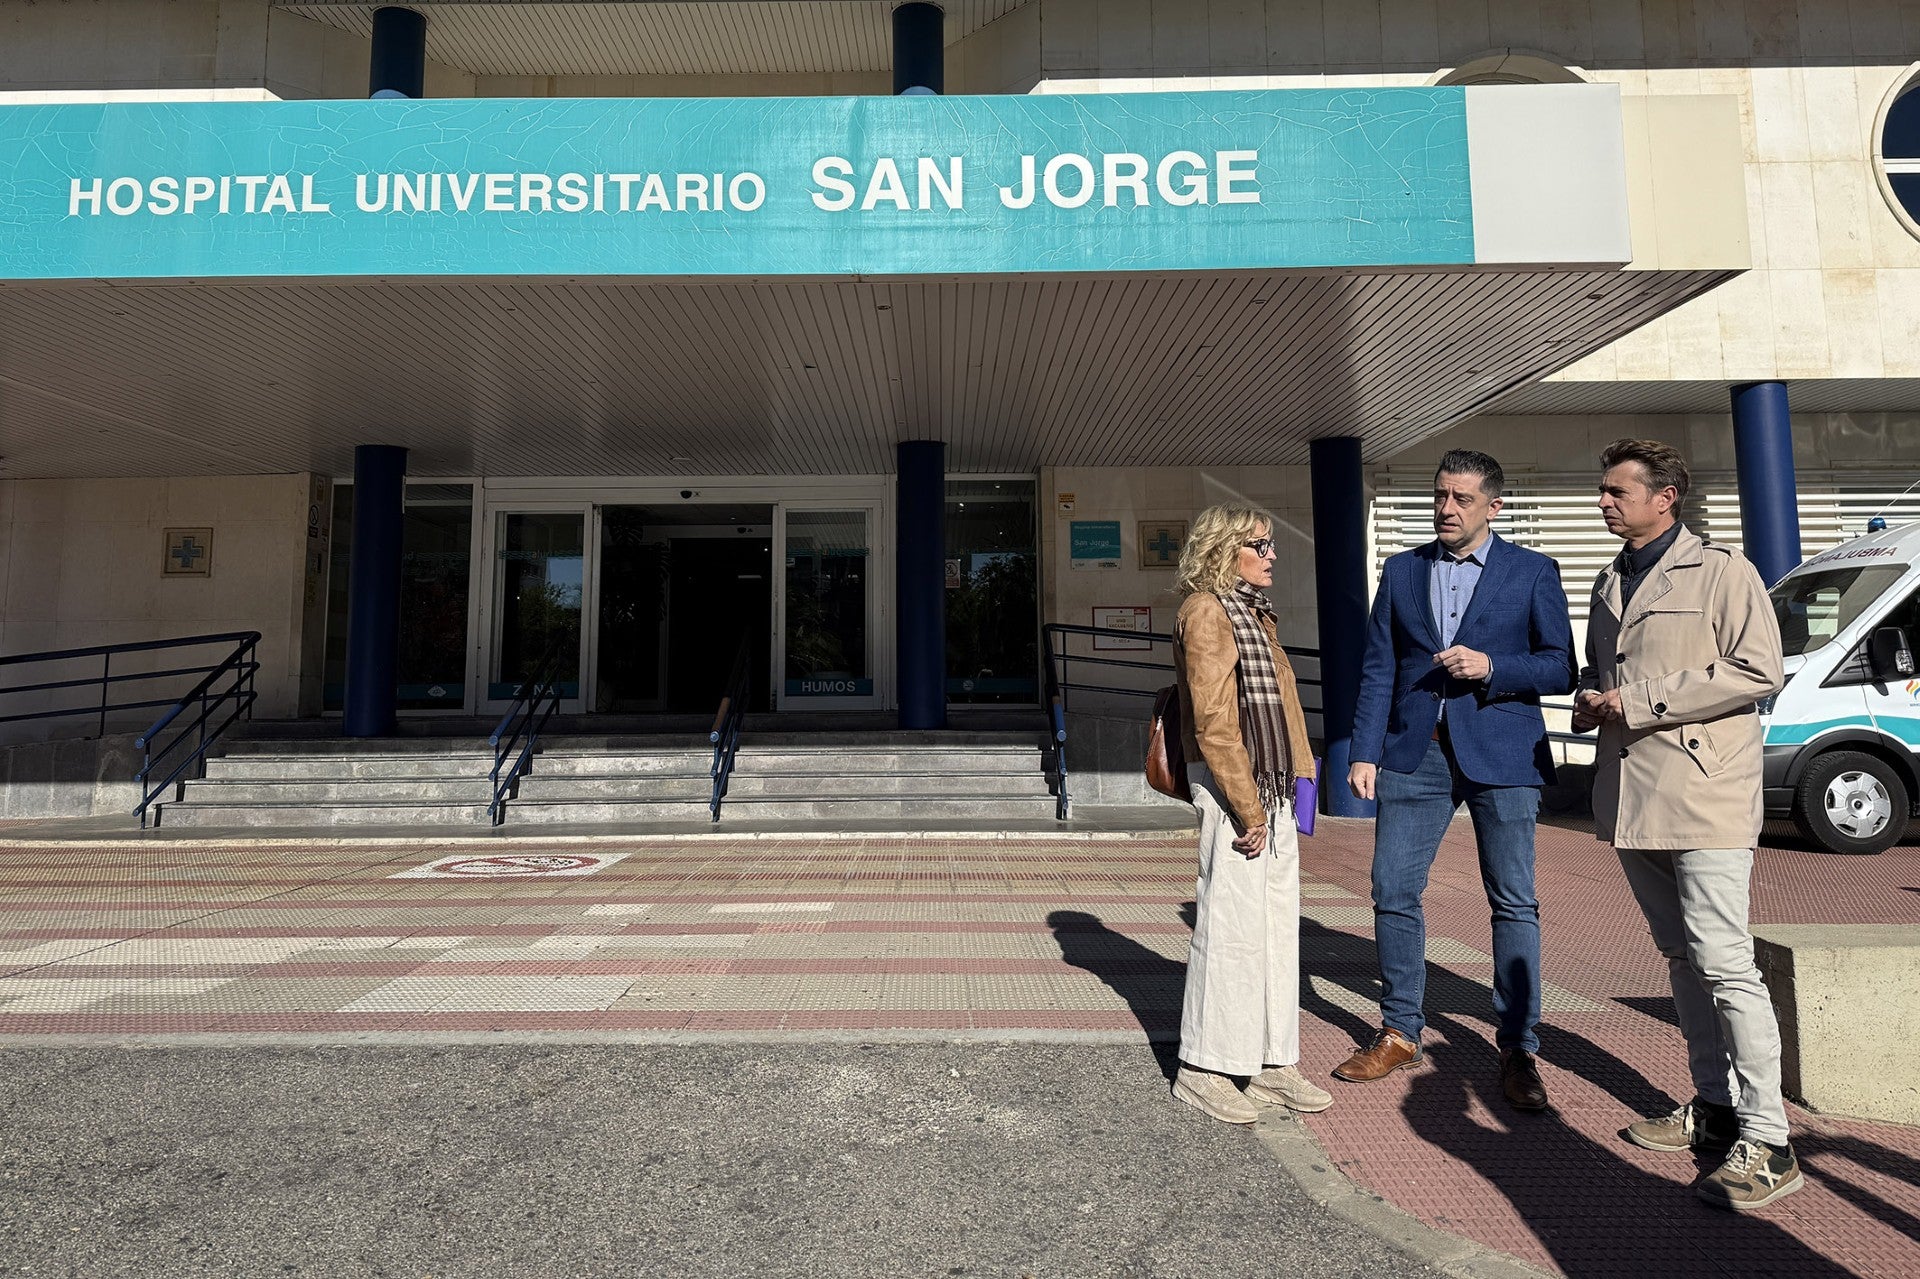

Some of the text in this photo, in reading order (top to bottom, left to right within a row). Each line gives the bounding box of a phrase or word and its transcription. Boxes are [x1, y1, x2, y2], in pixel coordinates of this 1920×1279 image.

[68, 149, 1261, 217] HOSPITAL UNIVERSITARIO SAN JORGE
[1089, 539, 1110, 547] Jorge
[512, 683, 555, 697] ZNA
[801, 680, 857, 693] HUMOS
